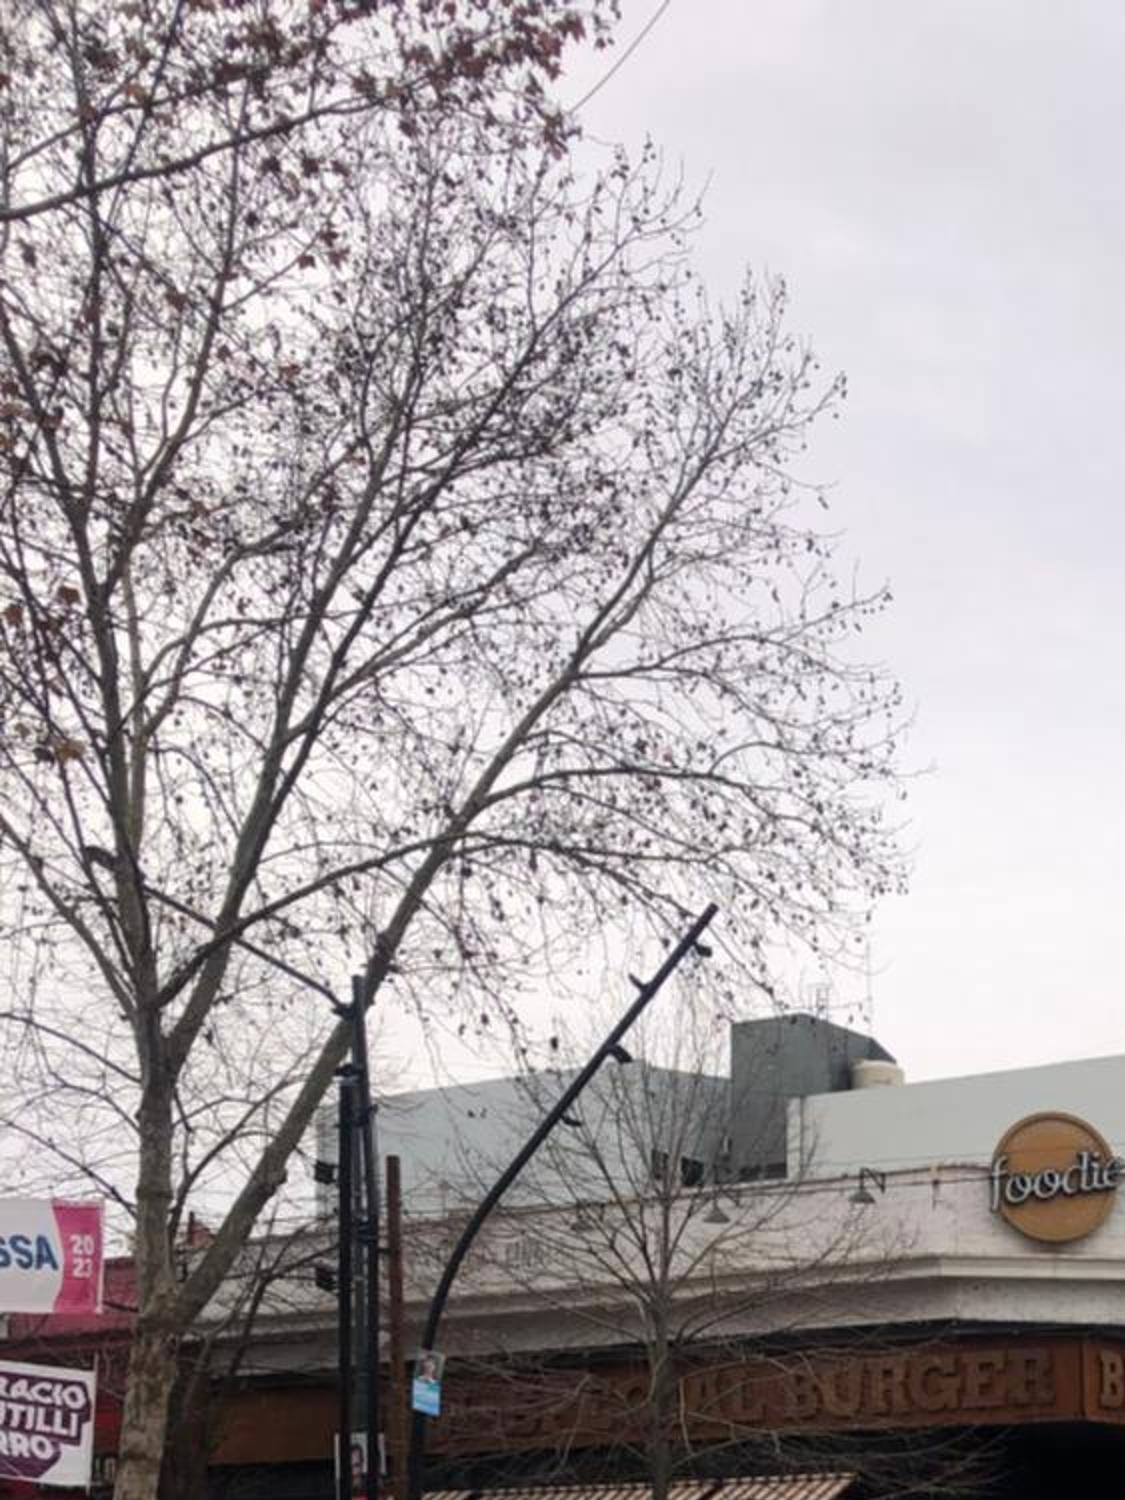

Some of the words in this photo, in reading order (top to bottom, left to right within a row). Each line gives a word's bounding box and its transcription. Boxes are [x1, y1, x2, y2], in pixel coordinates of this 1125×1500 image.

[991, 1152, 1125, 1212] foodie
[70, 1234, 94, 1256] 20
[73, 1258, 93, 1278] 23
[783, 1350, 1056, 1420] BURGER
[0, 1401, 78, 1437] TILLI
